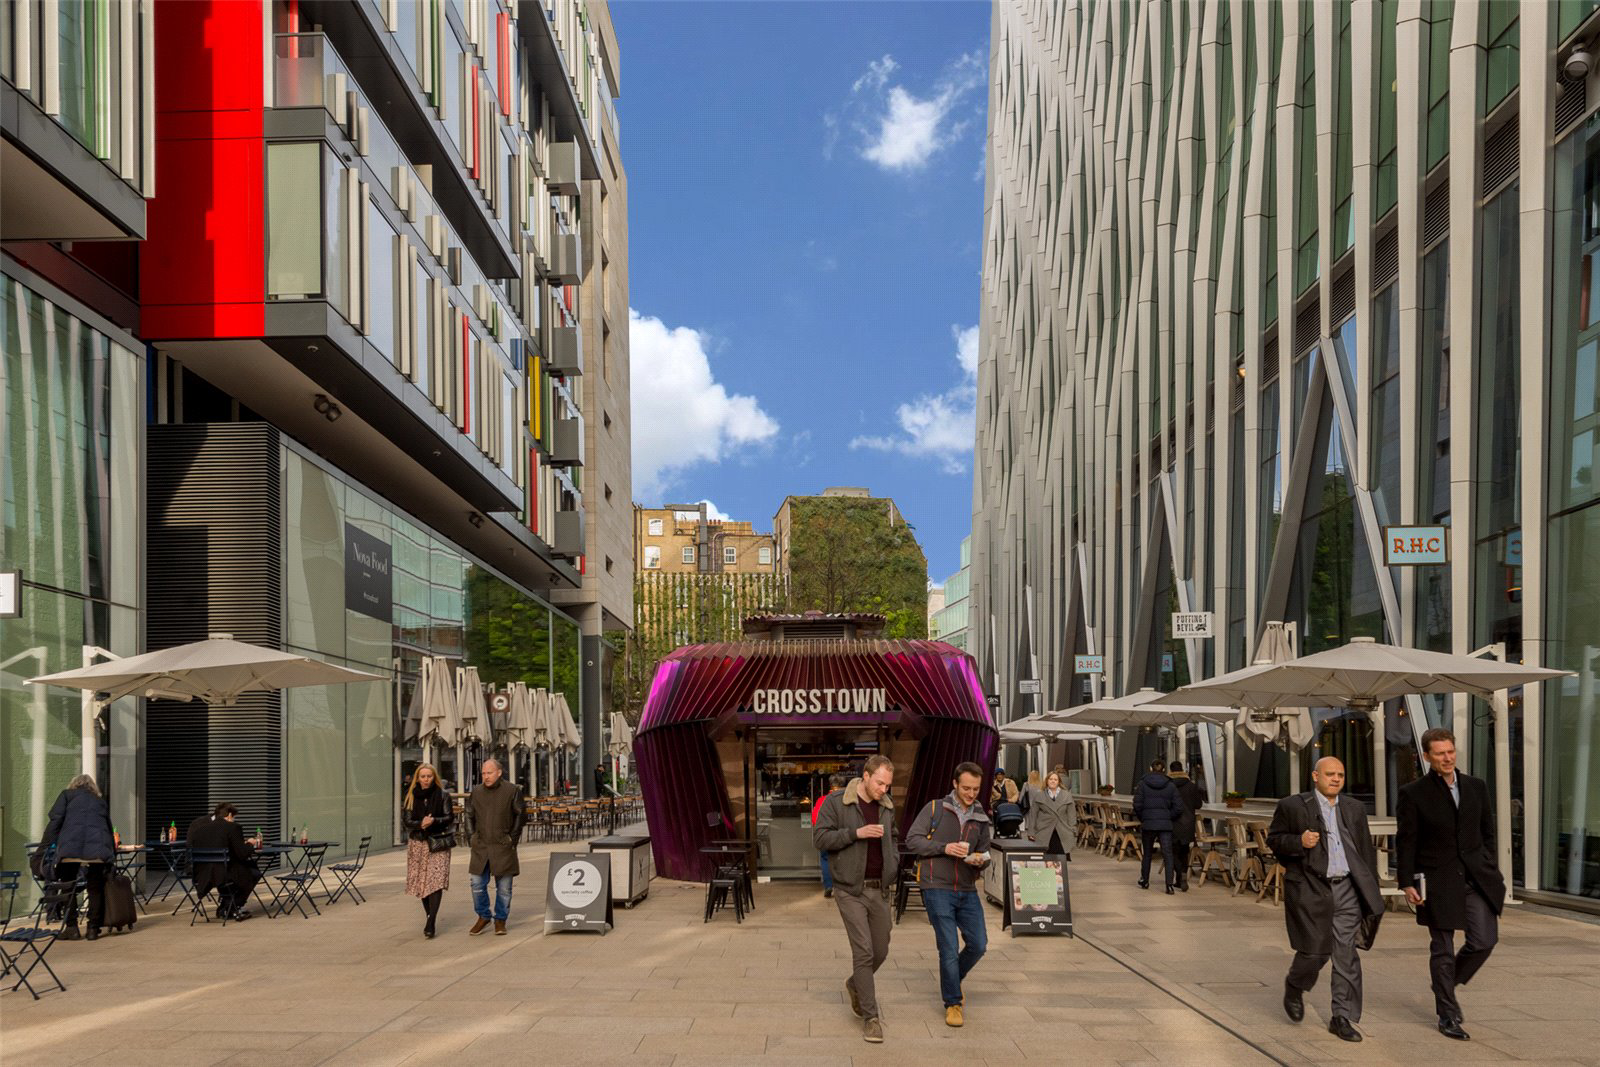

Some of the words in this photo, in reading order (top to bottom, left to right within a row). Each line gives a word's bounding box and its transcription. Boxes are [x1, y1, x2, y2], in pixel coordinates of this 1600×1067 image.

[1393, 537, 1440, 553] R.H.C
[353, 542, 371, 568] Nova
[371, 551, 388, 575] Food
[753, 688, 886, 714] CROSSTOWN
[567, 868, 585, 886] £2
